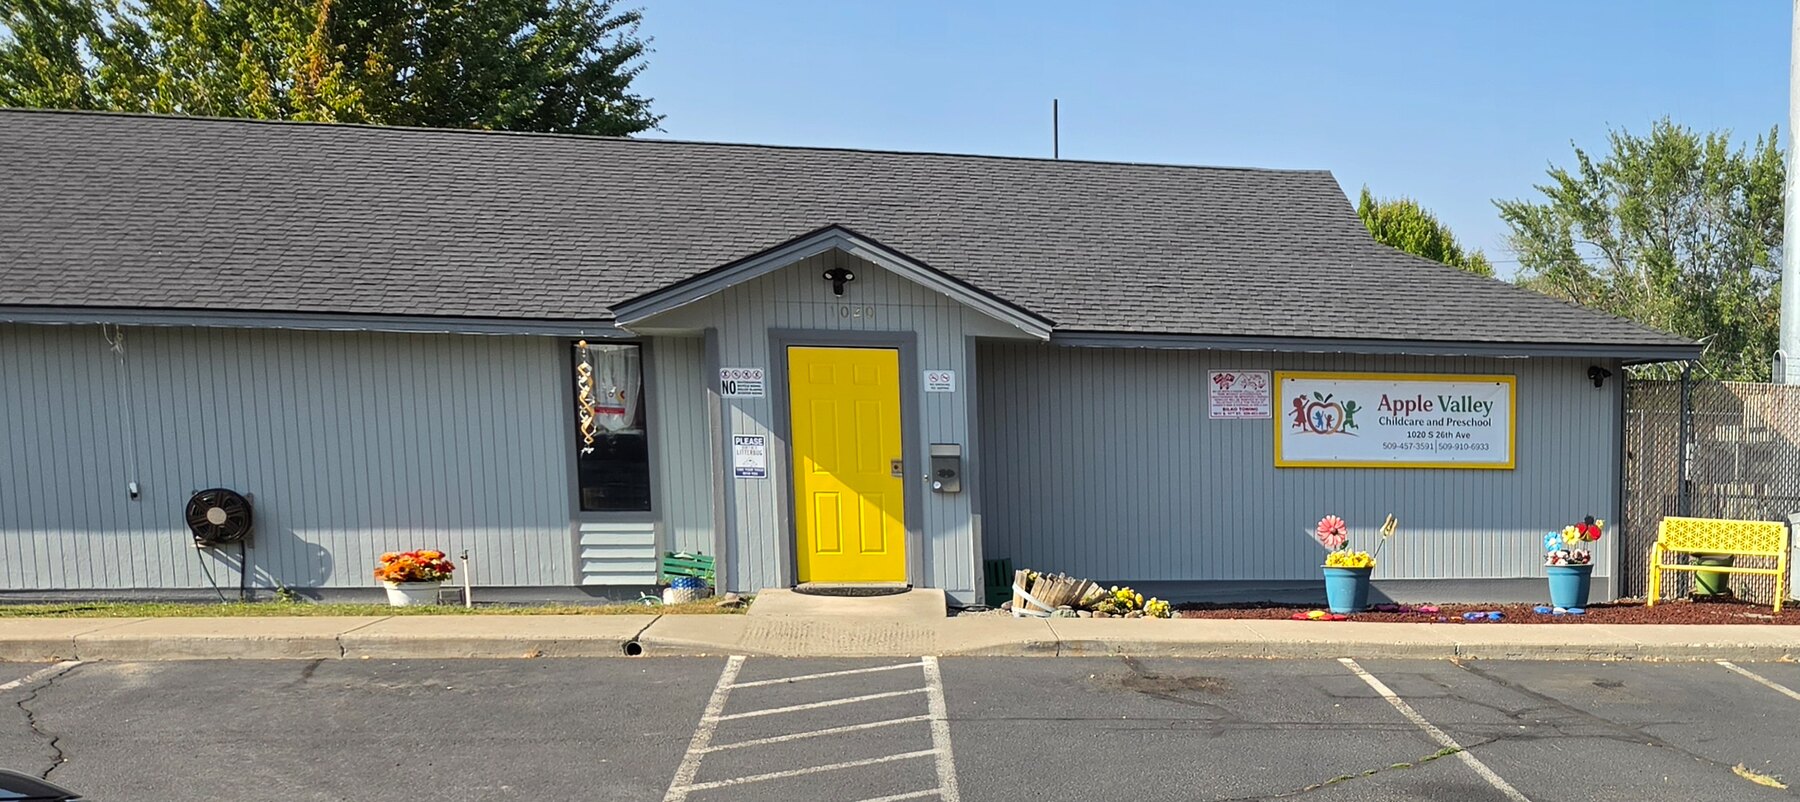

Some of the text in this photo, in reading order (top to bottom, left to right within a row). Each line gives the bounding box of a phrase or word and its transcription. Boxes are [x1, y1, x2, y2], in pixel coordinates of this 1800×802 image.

[722, 380, 736, 395] NO
[1377, 394, 1494, 418] Apple Valley
[1378, 416, 1492, 427] Childcare and Preschool
[1407, 431, 1471, 439] 1020 S 26th Ave
[735, 437, 763, 446] PLEASE
[1382, 442, 1489, 451] 509-457-3591 509-910-6933
